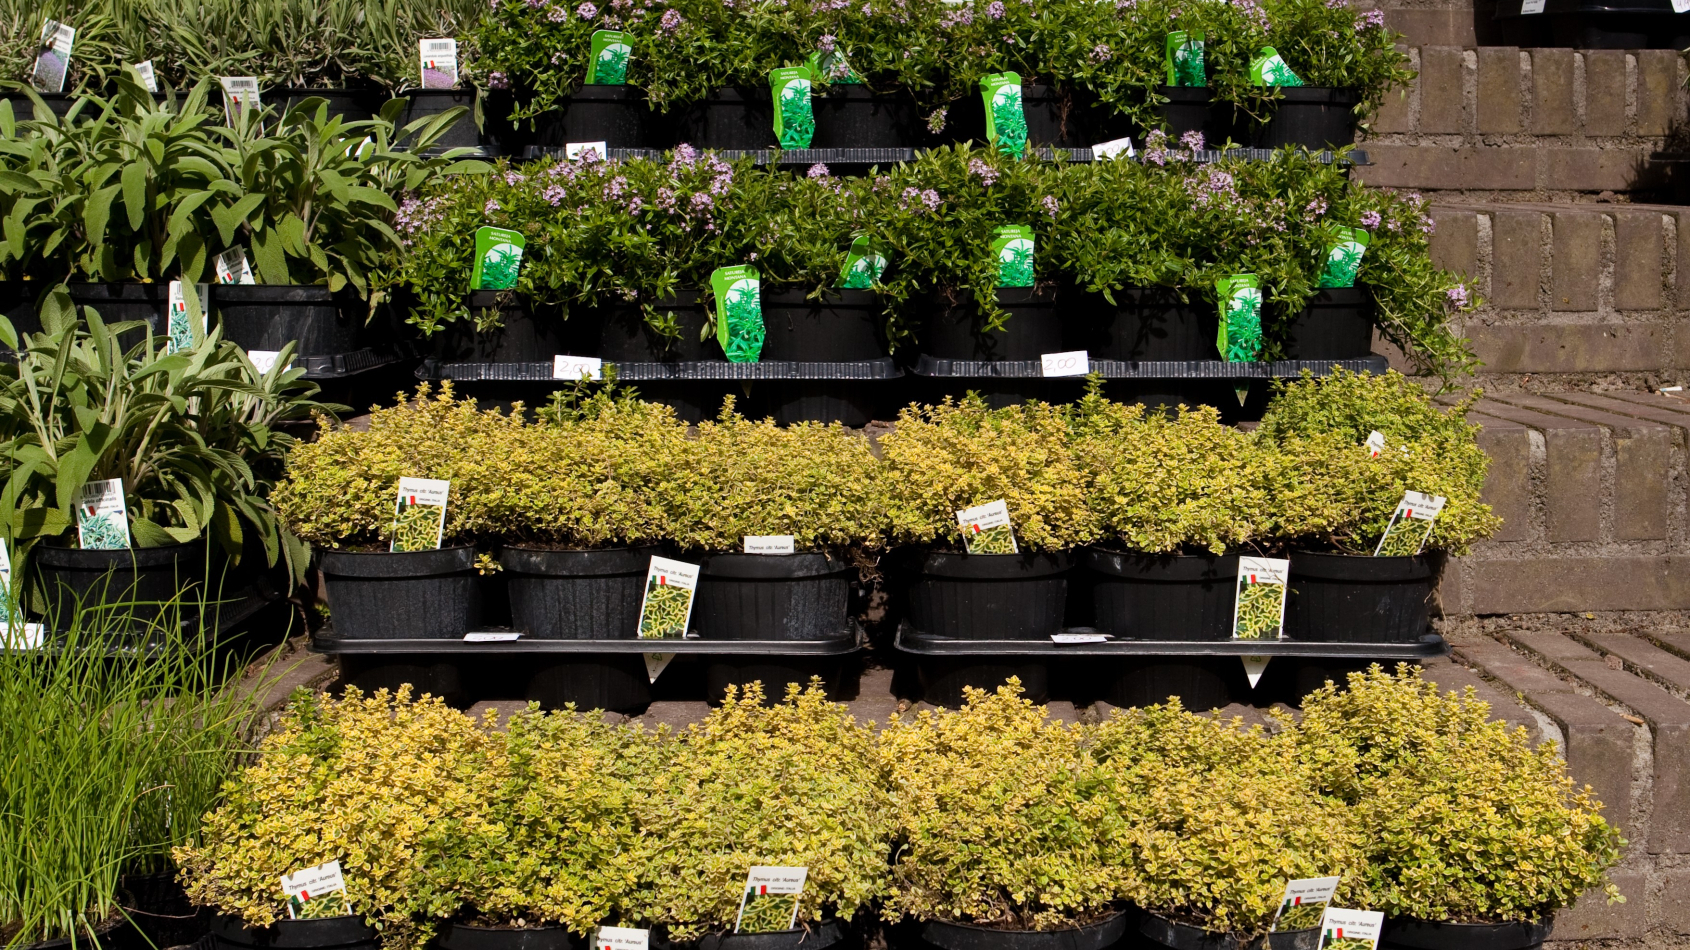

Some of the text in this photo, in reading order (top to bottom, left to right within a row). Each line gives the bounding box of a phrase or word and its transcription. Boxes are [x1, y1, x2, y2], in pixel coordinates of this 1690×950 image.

[560, 361, 590, 376] 2,00
[1044, 357, 1076, 372] 2,00
[289, 882, 307, 891] Thymus
